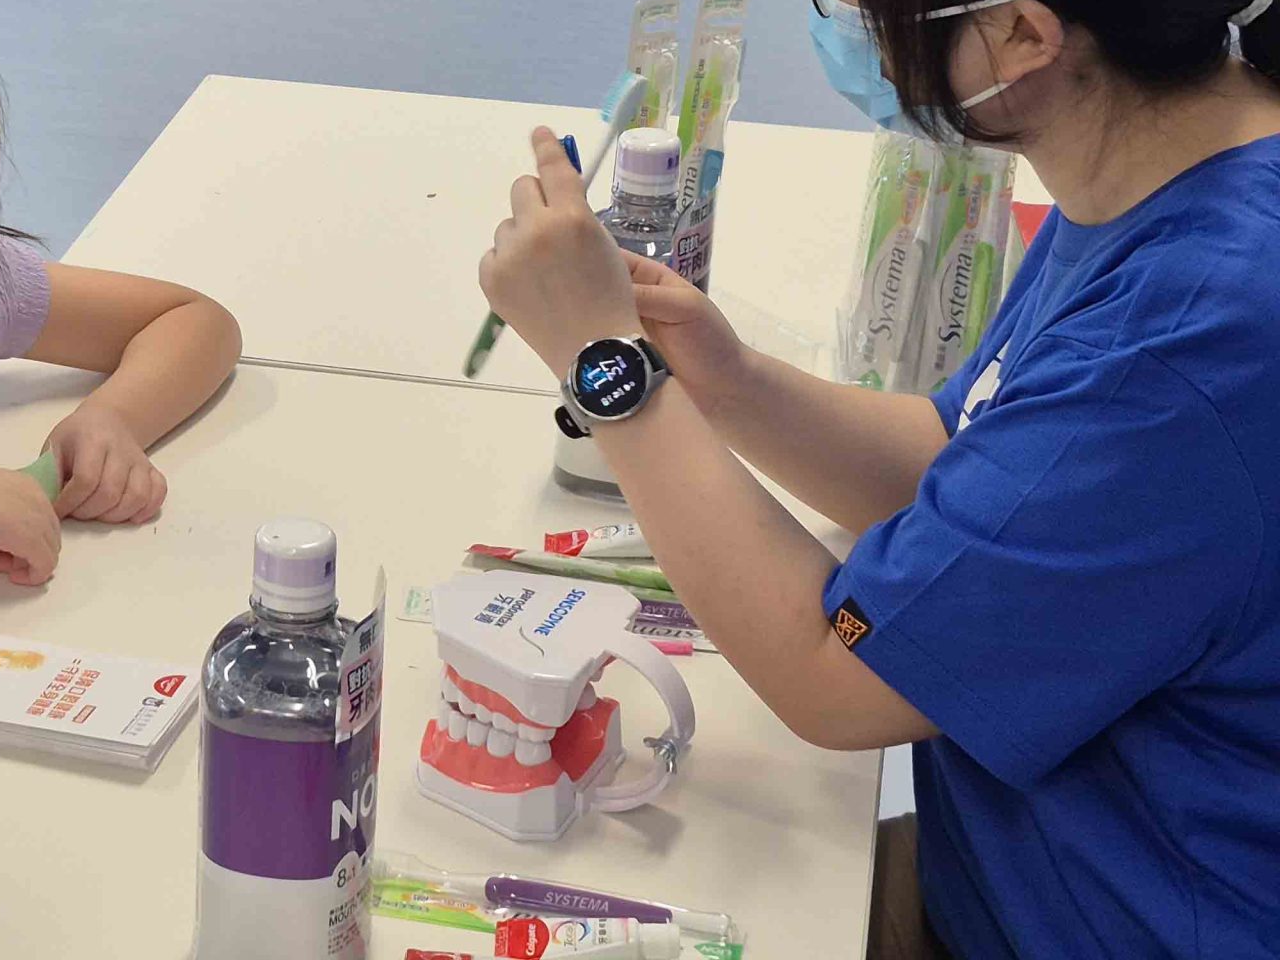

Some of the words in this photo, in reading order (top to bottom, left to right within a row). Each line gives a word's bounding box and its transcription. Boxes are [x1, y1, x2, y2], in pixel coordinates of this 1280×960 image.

[870, 246, 907, 341] Systema
[938, 251, 973, 343] Systema
[534, 588, 586, 636] SENSODYNE
[544, 891, 609, 913] SYSTEMA
[526, 923, 538, 956] Colgate
